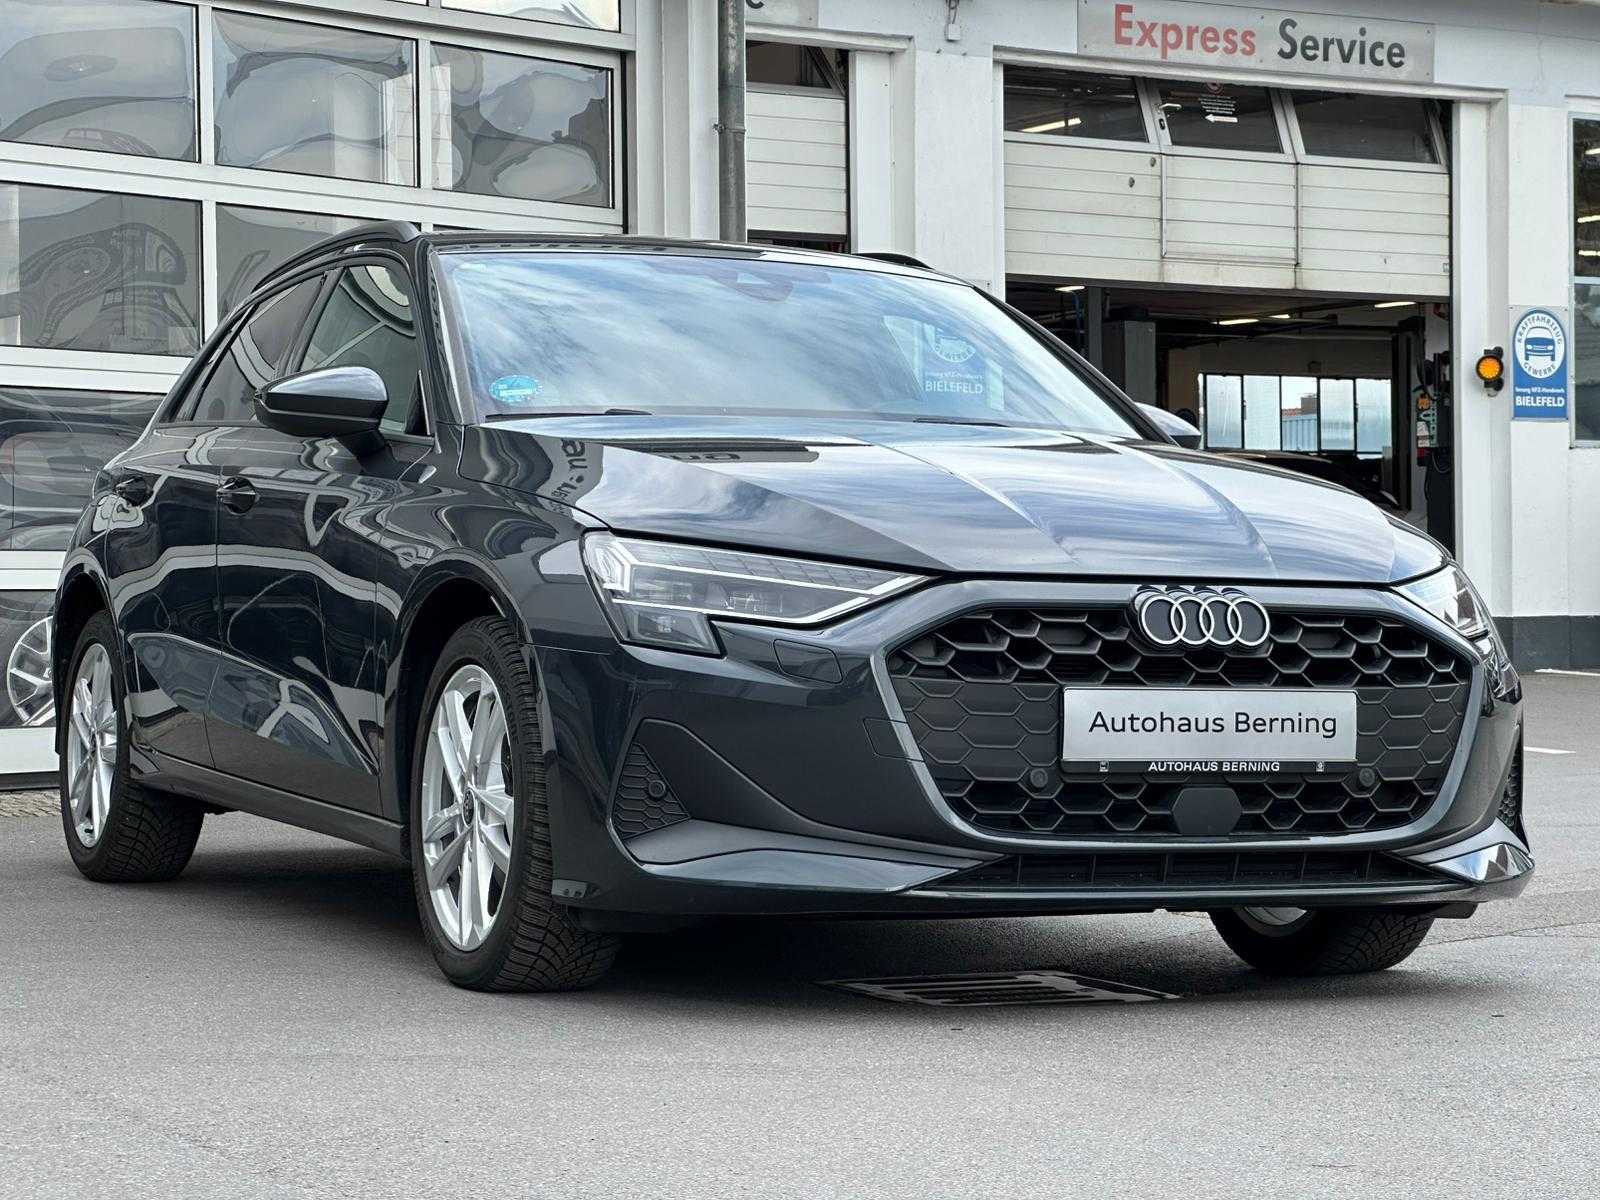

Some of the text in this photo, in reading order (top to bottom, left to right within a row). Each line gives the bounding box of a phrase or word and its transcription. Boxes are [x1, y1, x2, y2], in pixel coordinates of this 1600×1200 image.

[1113, 3, 1407, 69] Express Service
[1516, 315, 1564, 345] KRAFTFAHRZEUG
[1523, 361, 1557, 377] GEWERBE
[1515, 395, 1565, 407] BIELEFELD
[1088, 711, 1337, 738] Autohaus Berning
[1147, 761, 1281, 772] AUTOHAUS BERNING
